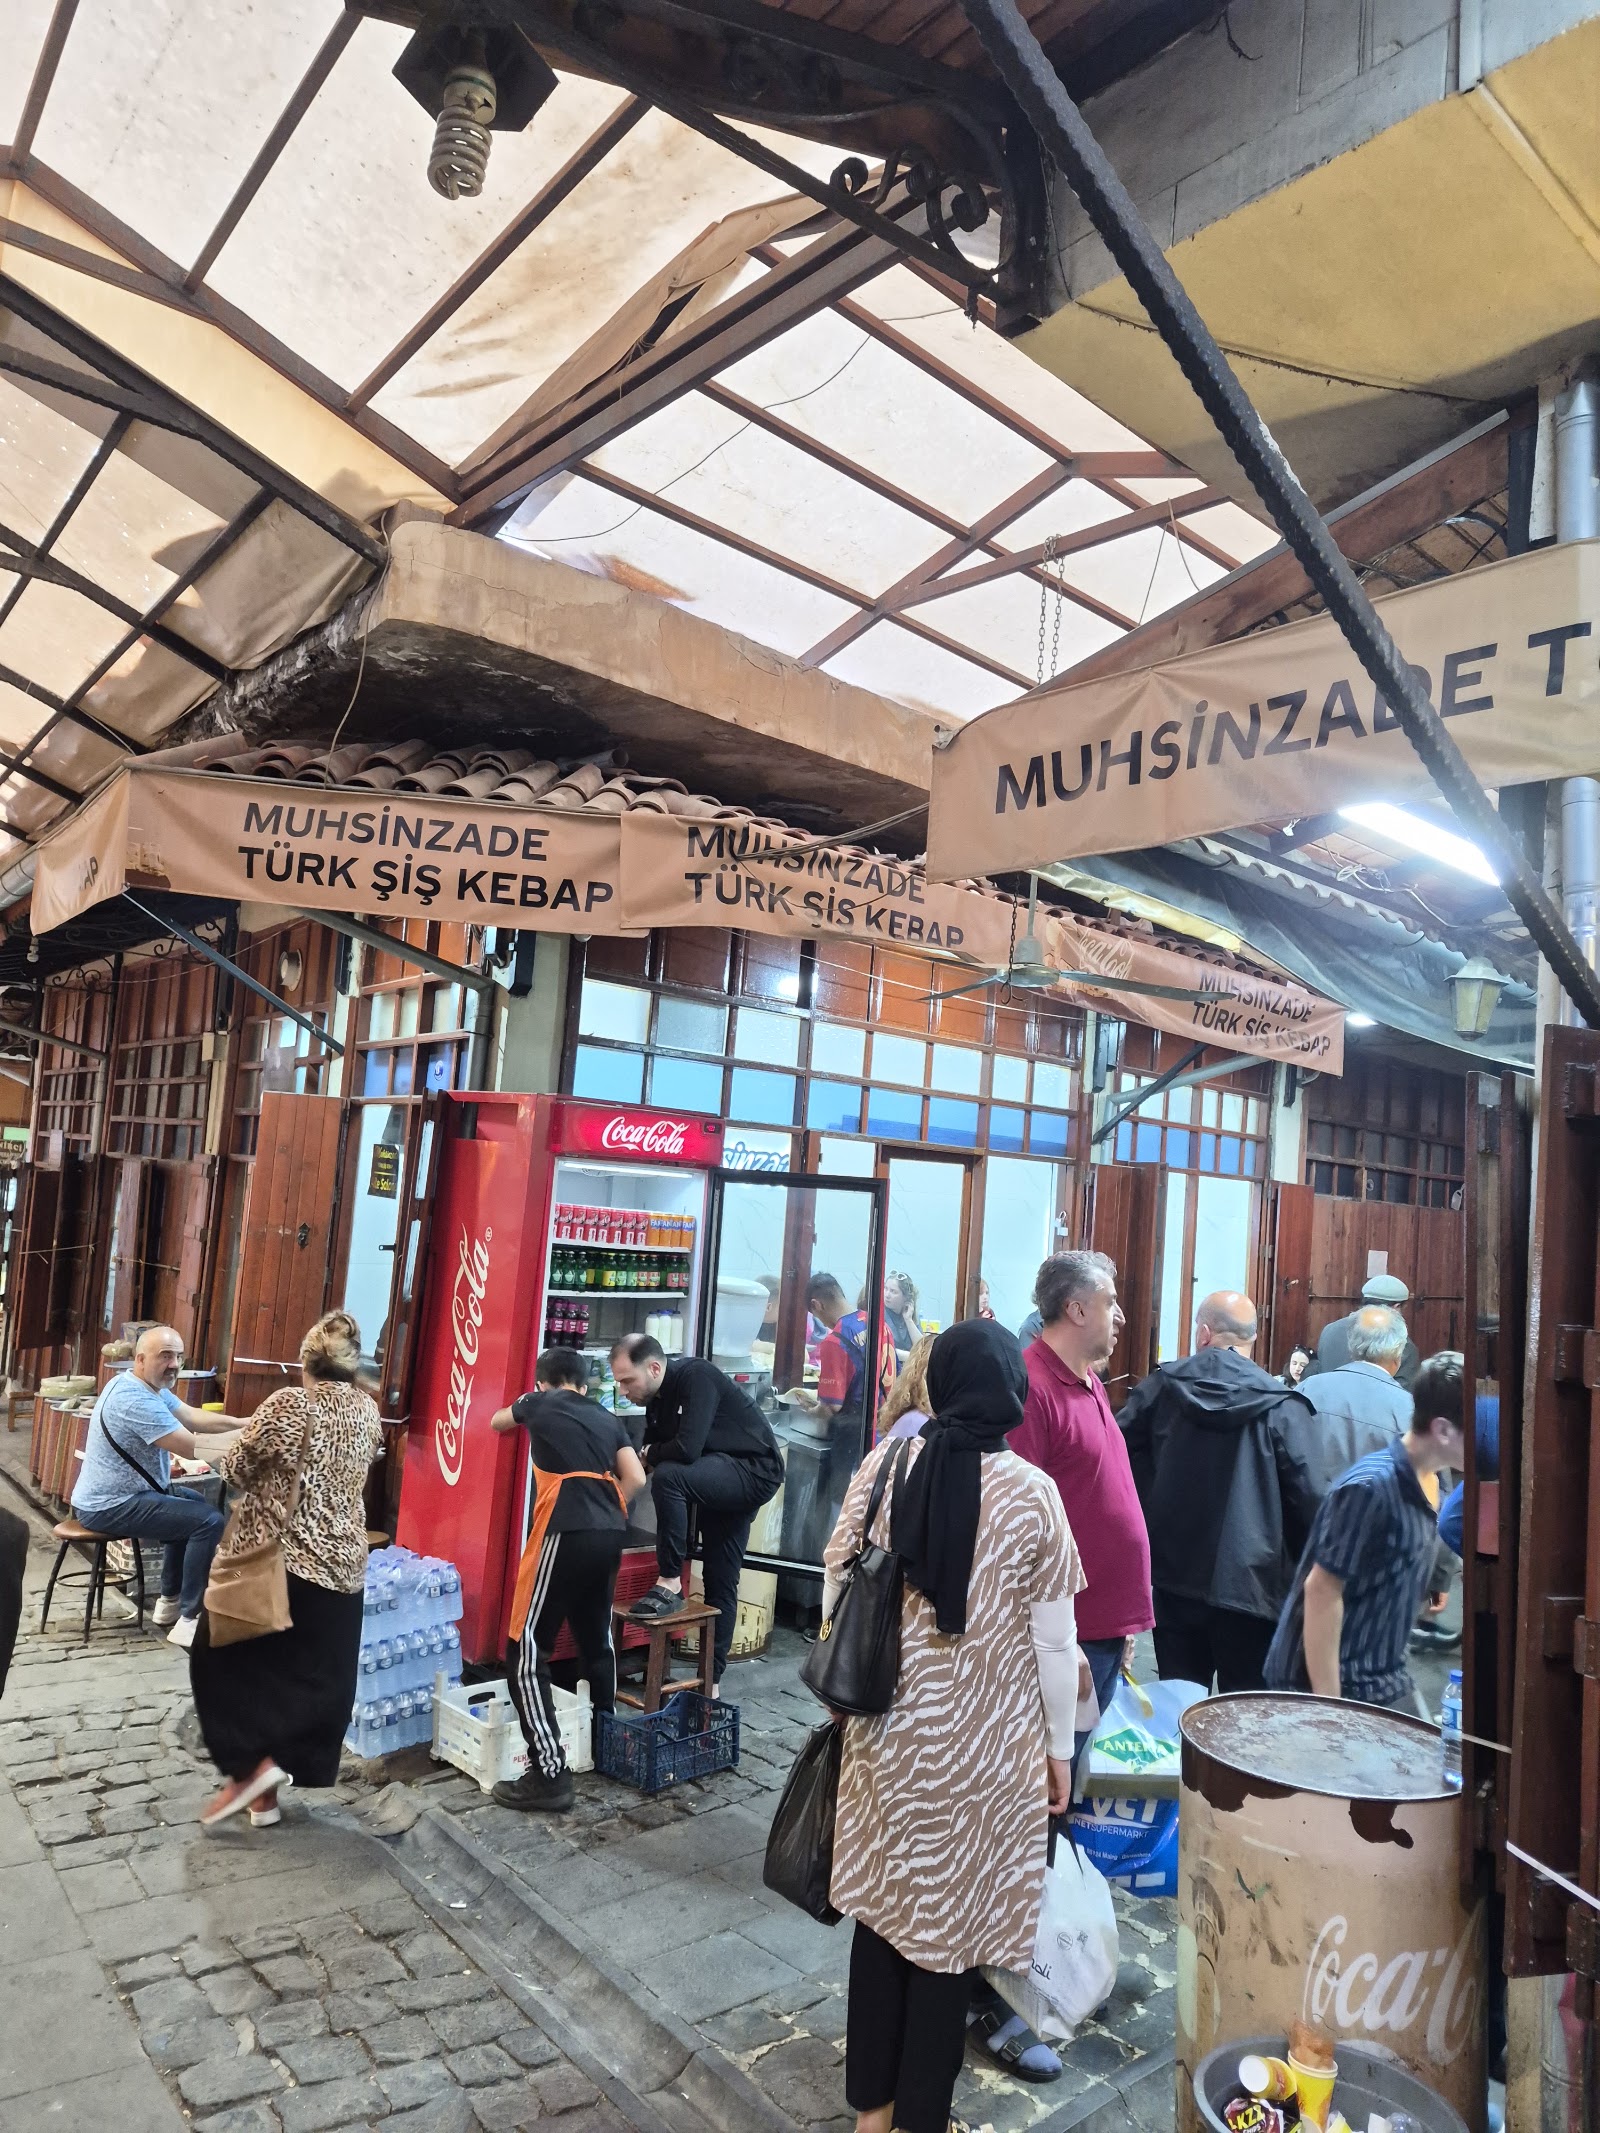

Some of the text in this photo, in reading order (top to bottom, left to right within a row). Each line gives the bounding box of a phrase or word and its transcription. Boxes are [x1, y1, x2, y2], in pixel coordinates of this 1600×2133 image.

[243, 802, 550, 861] MUHSİNZADE
[238, 841, 614, 913] TÜRK ŞİŞ KEBAP
[685, 863, 794, 916] TÜRK
[865, 904, 964, 948] KEBAP
[1192, 1000, 1242, 1035] TÜRK
[602, 1116, 690, 1155] Coca-Cola
[435, 1222, 490, 1486] Coca-Cola
[1074, 1817, 1149, 1840] NETSUPERMARKT
